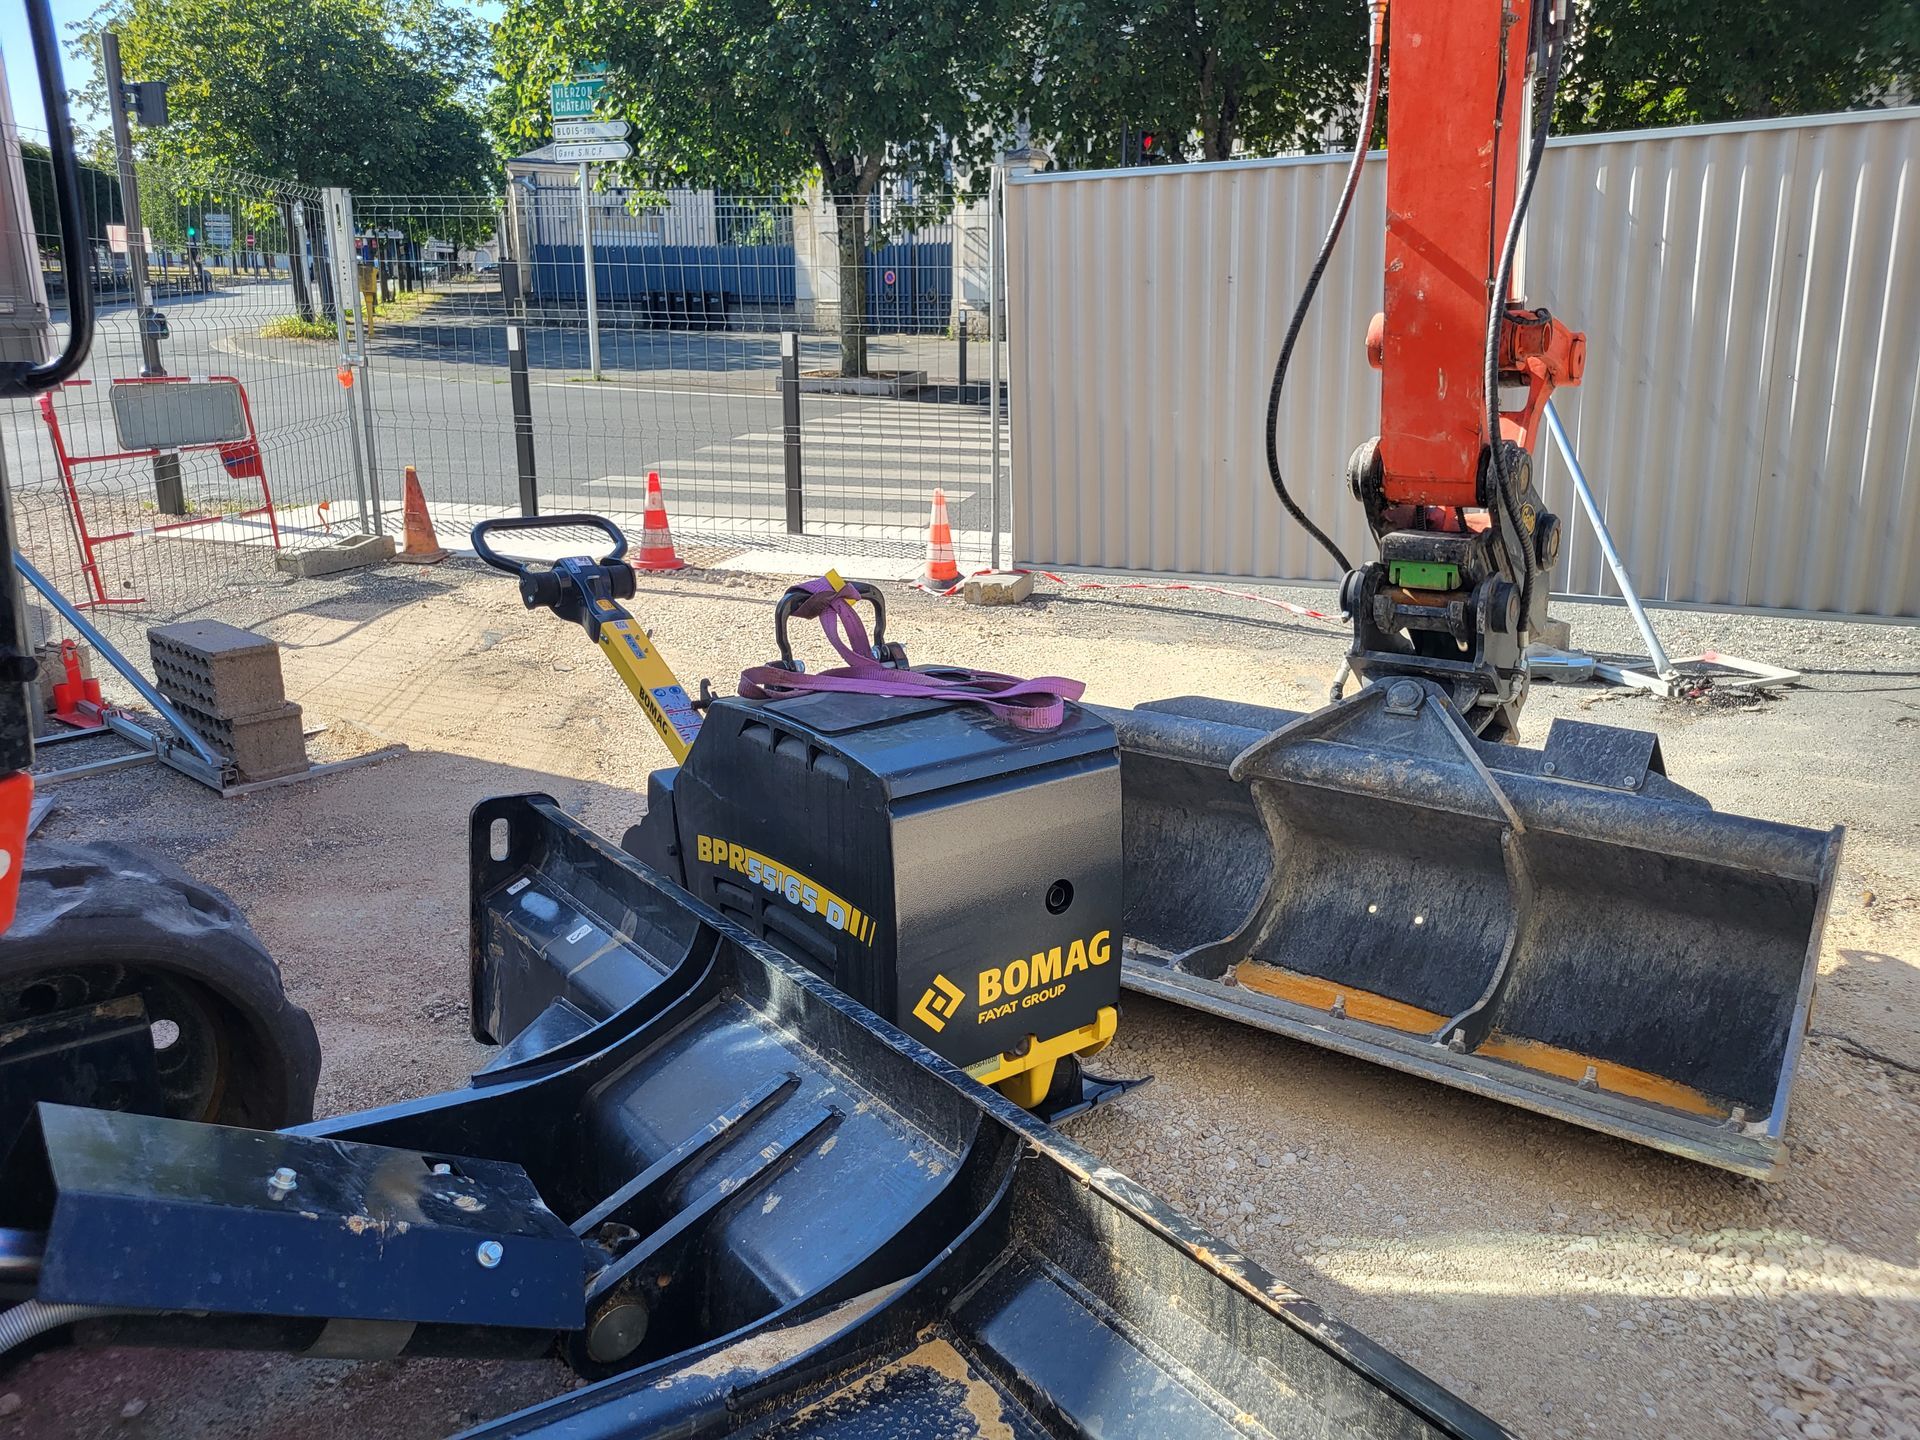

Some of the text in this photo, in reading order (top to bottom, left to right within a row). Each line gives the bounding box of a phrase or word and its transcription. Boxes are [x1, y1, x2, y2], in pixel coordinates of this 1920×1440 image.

[555, 86, 593, 99] VIERZON
[558, 149, 574, 158] Gare
[639, 686, 668, 735] BOMAG
[697, 834, 746, 874] BPR
[825, 899, 846, 931] D
[978, 930, 1111, 1006] BOMAG
[978, 983, 1066, 1024] FAYAT GROUP
